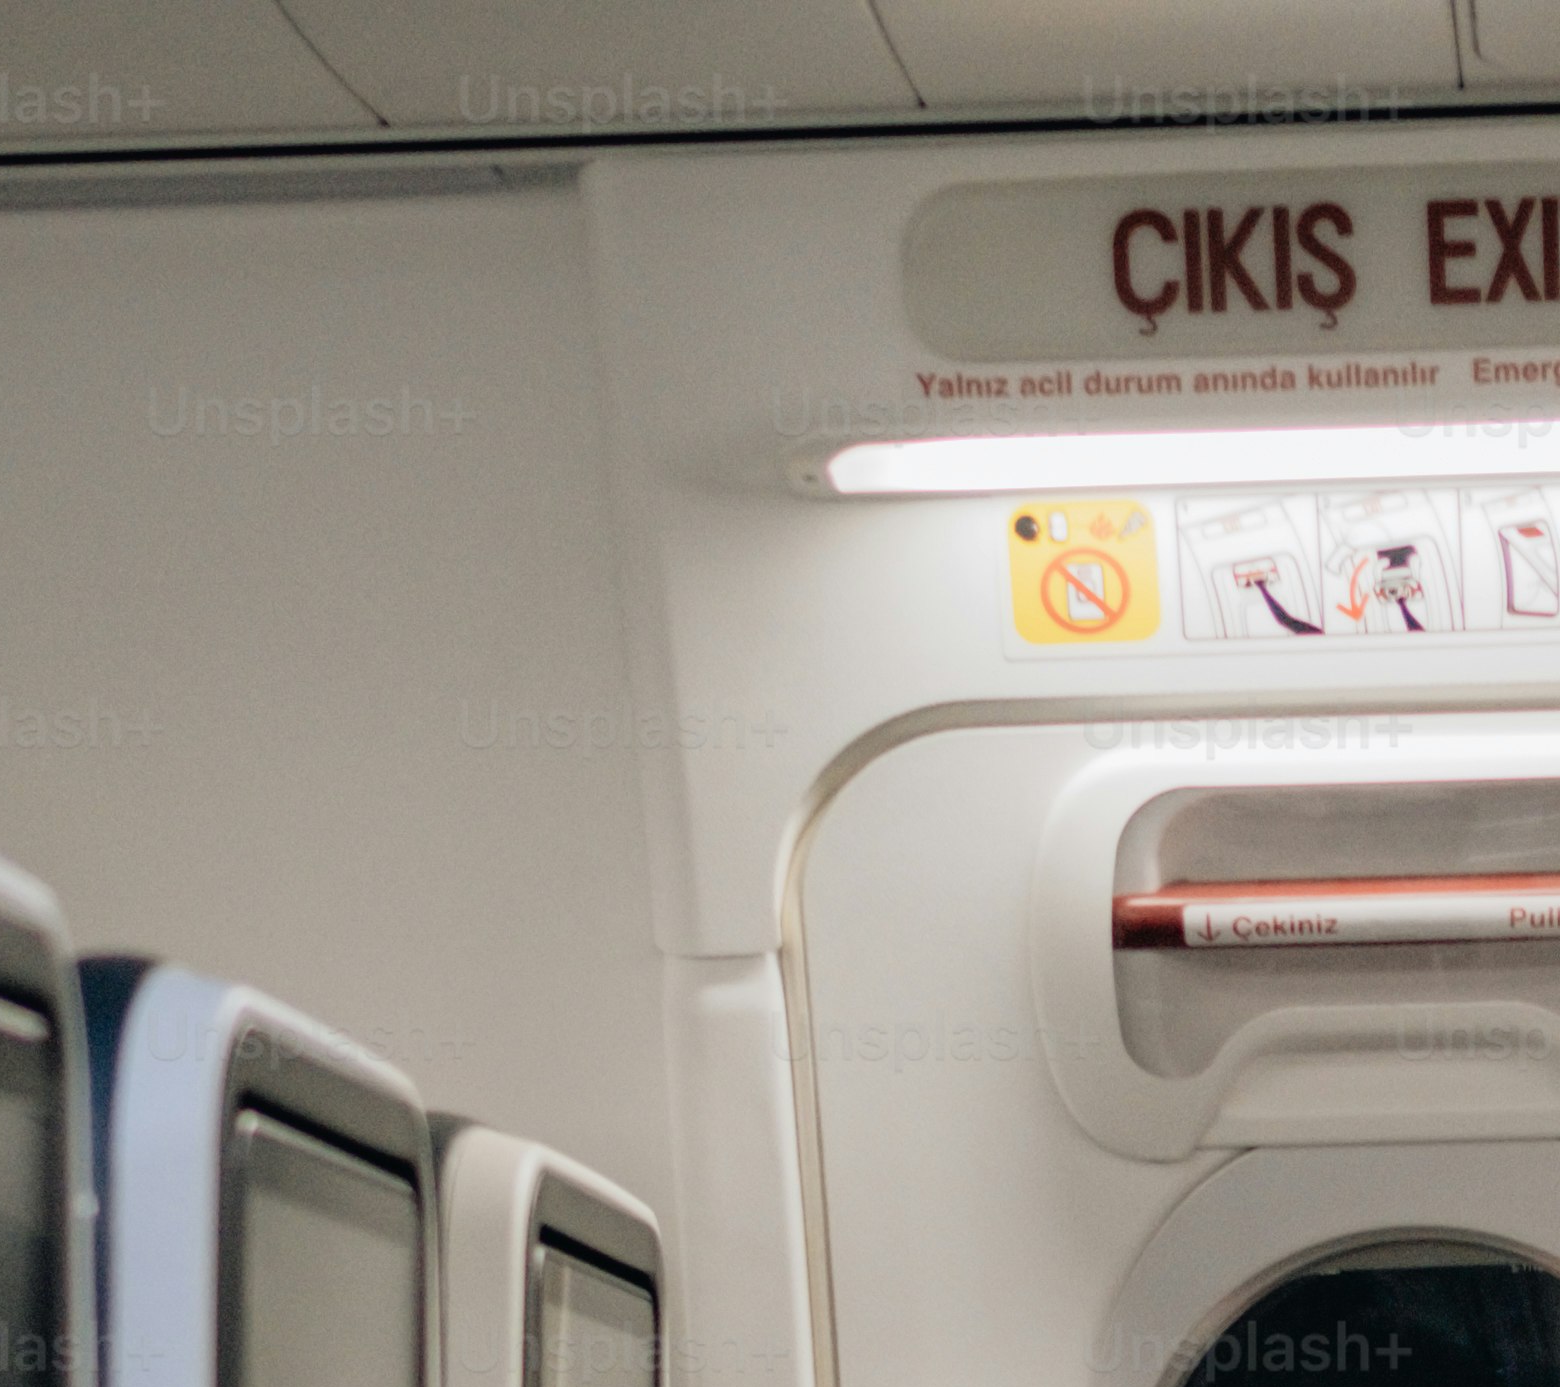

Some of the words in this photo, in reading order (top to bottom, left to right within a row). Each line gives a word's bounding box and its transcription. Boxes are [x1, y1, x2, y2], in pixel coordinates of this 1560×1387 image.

[1113, 203, 1356, 336] ÇIKIŞ
[916, 372, 1009, 399] Yalnız
[1020, 371, 1072, 397] acil
[1084, 370, 1182, 396] durum
[1193, 365, 1296, 394] anında
[1307, 361, 1439, 391] kullanılır
[1232, 915, 1338, 942] Çekiniz
